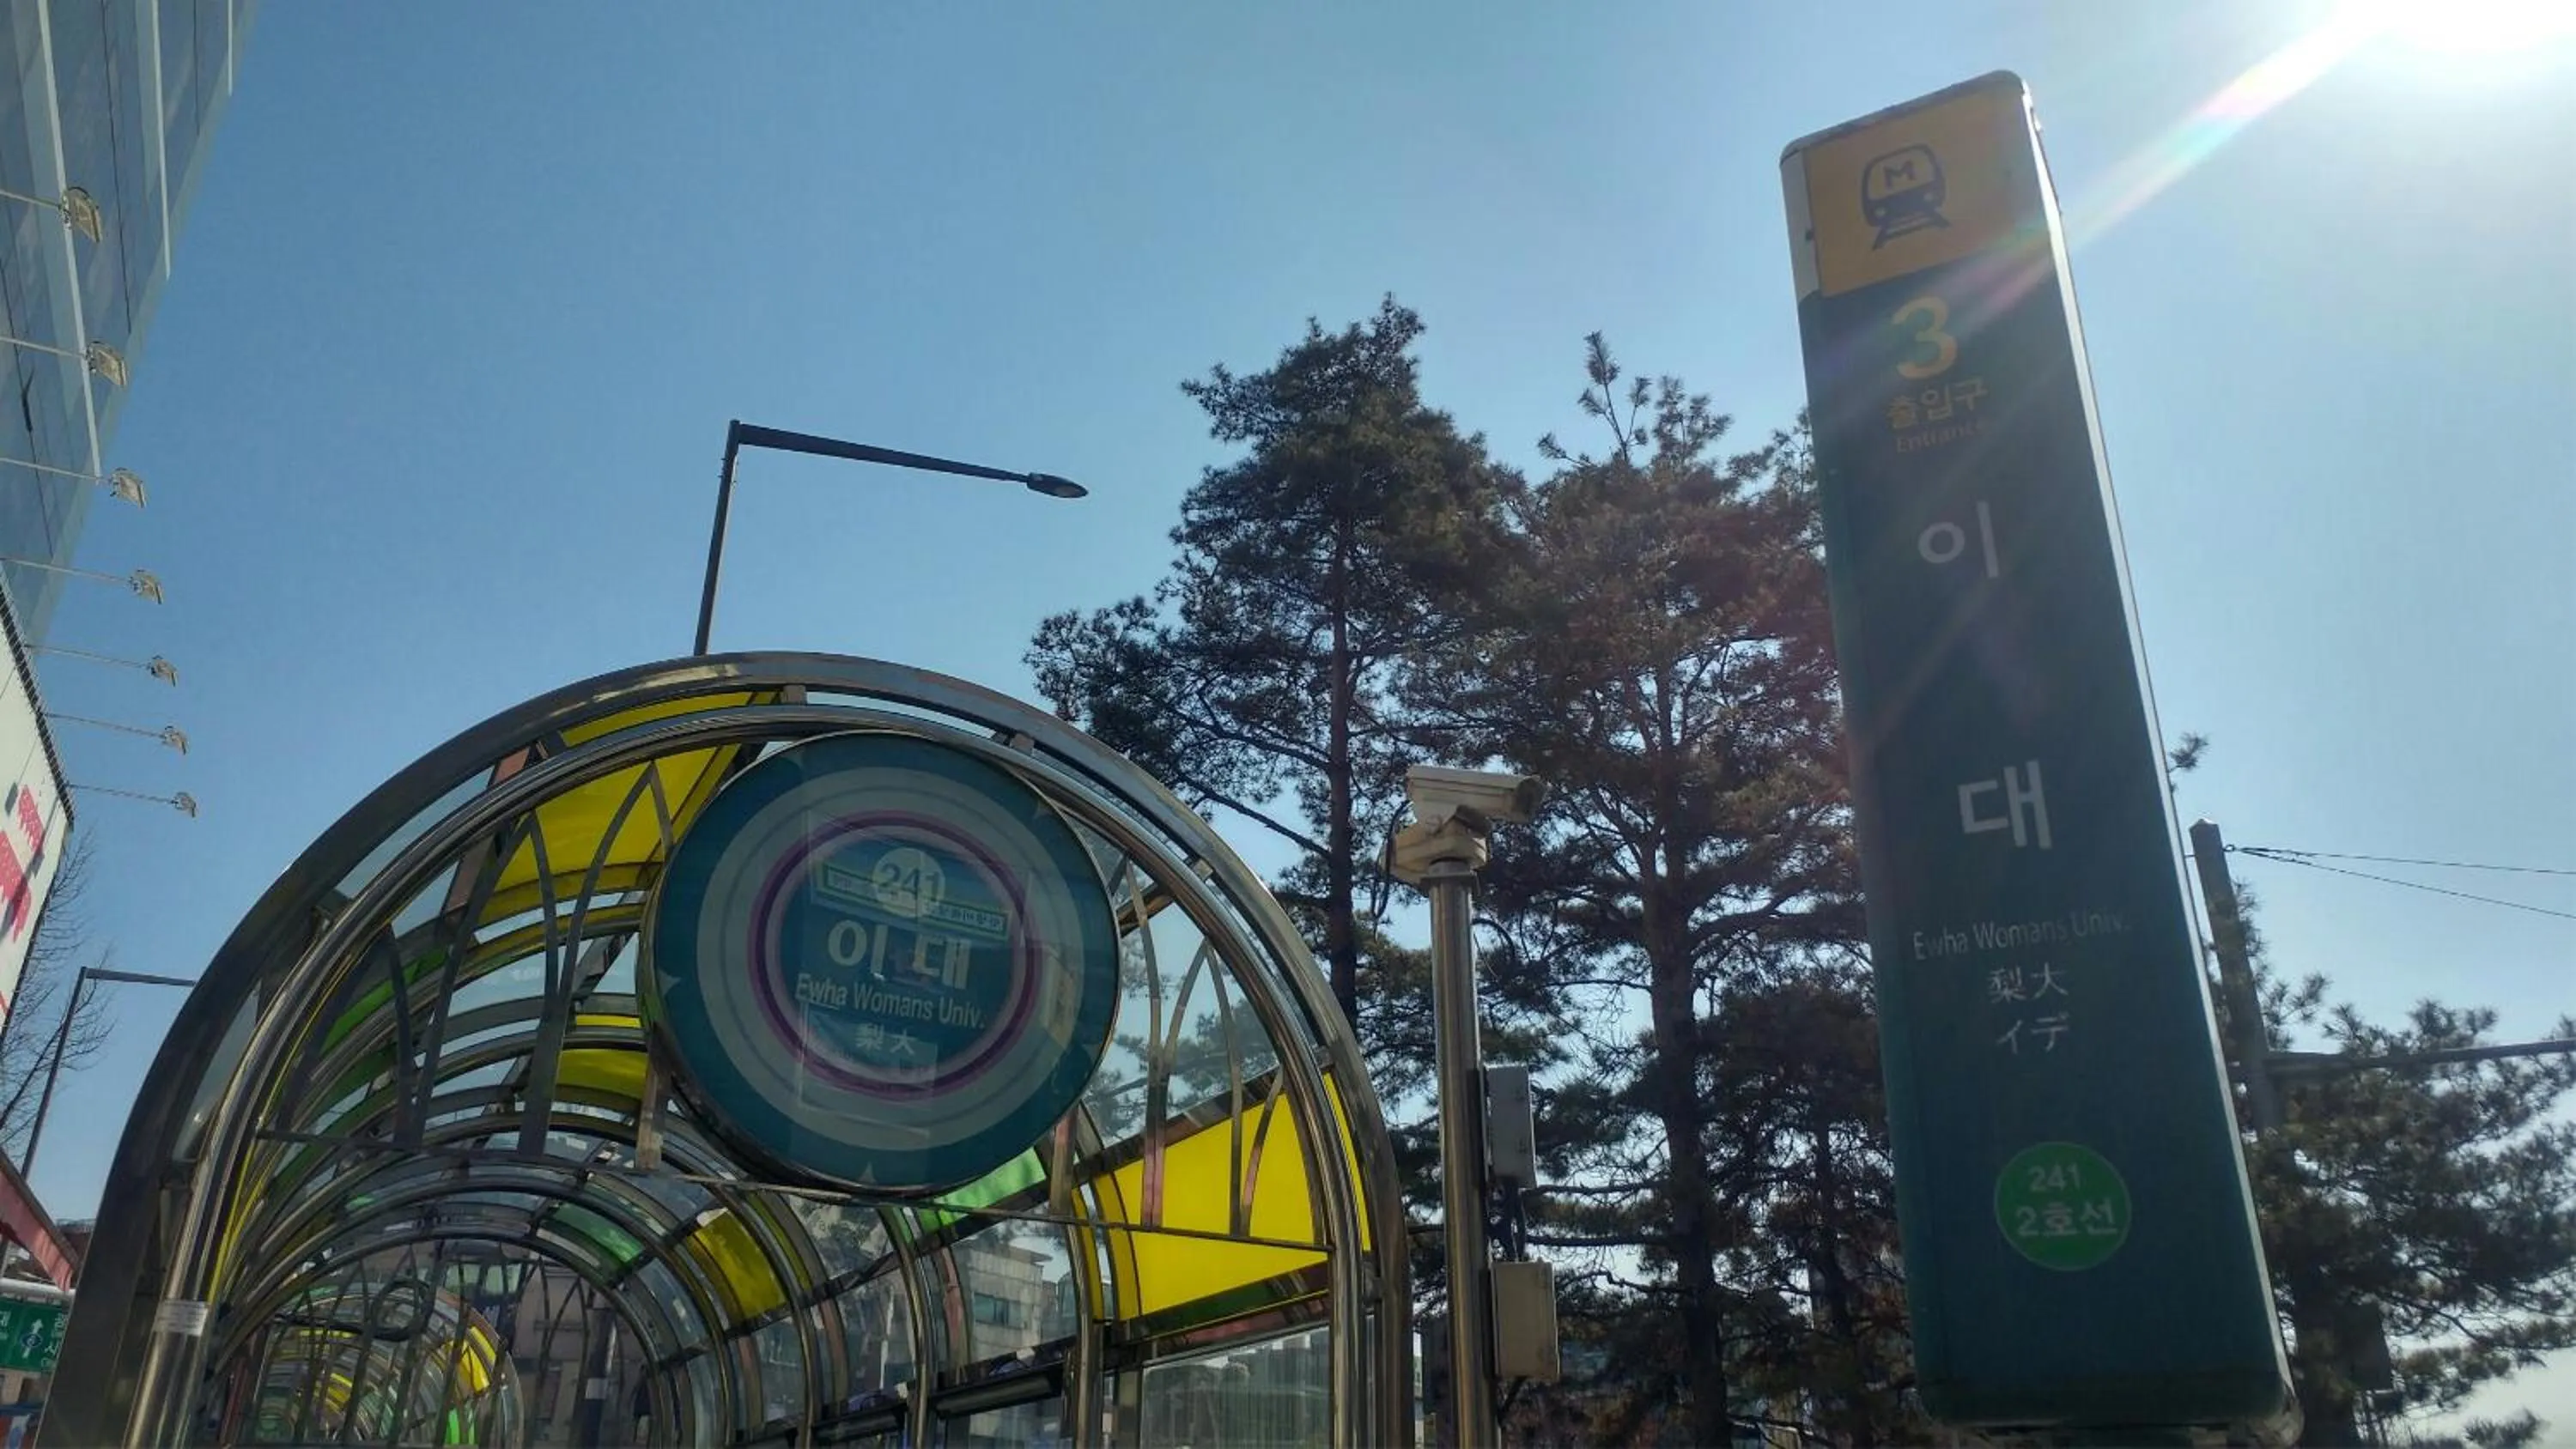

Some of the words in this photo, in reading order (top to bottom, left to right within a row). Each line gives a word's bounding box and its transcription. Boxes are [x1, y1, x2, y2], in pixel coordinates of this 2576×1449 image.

[1892, 295, 1959, 380] 3
[1886, 376, 1990, 429] 출입구
[878, 863, 945, 904] 241
[828, 919, 972, 990] 이대
[1912, 927, 1969, 961] Ewha
[1972, 919, 2068, 949] Womans
[794, 973, 848, 1006] Ewha
[853, 981, 933, 1021] Womans
[938, 996, 987, 1029] Univ.
[1988, 961, 2069, 1004] 梨大
[855, 1022, 919, 1056] 梨大
[1995, 1010, 2069, 1055] イデ
[2027, 1162, 2081, 1192] 241
[2016, 1197, 2118, 1237] 2호선
